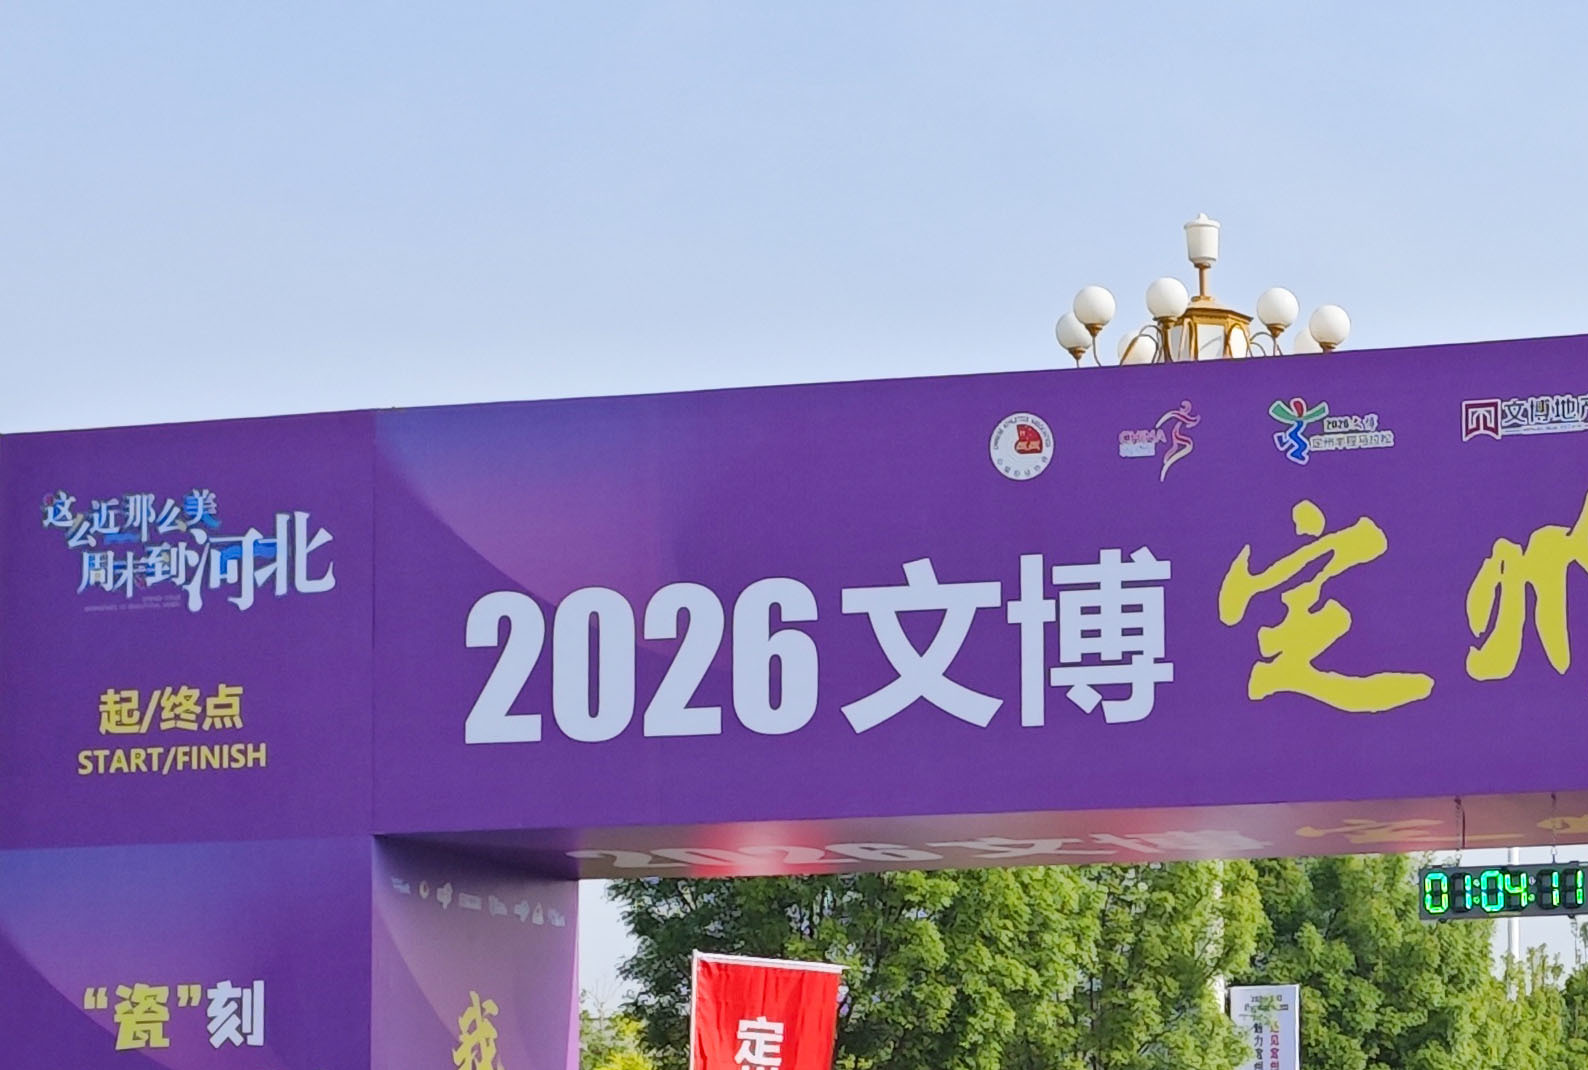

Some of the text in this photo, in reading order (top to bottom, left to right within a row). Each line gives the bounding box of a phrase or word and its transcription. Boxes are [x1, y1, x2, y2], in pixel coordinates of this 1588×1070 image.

[42, 489, 219, 548] 这么近那么美
[77, 511, 336, 612] 周末到河北
[98, 683, 243, 735] 起/终点
[78, 743, 266, 775] START/FINISH
[1425, 869, 1583, 913] 01:04:11
